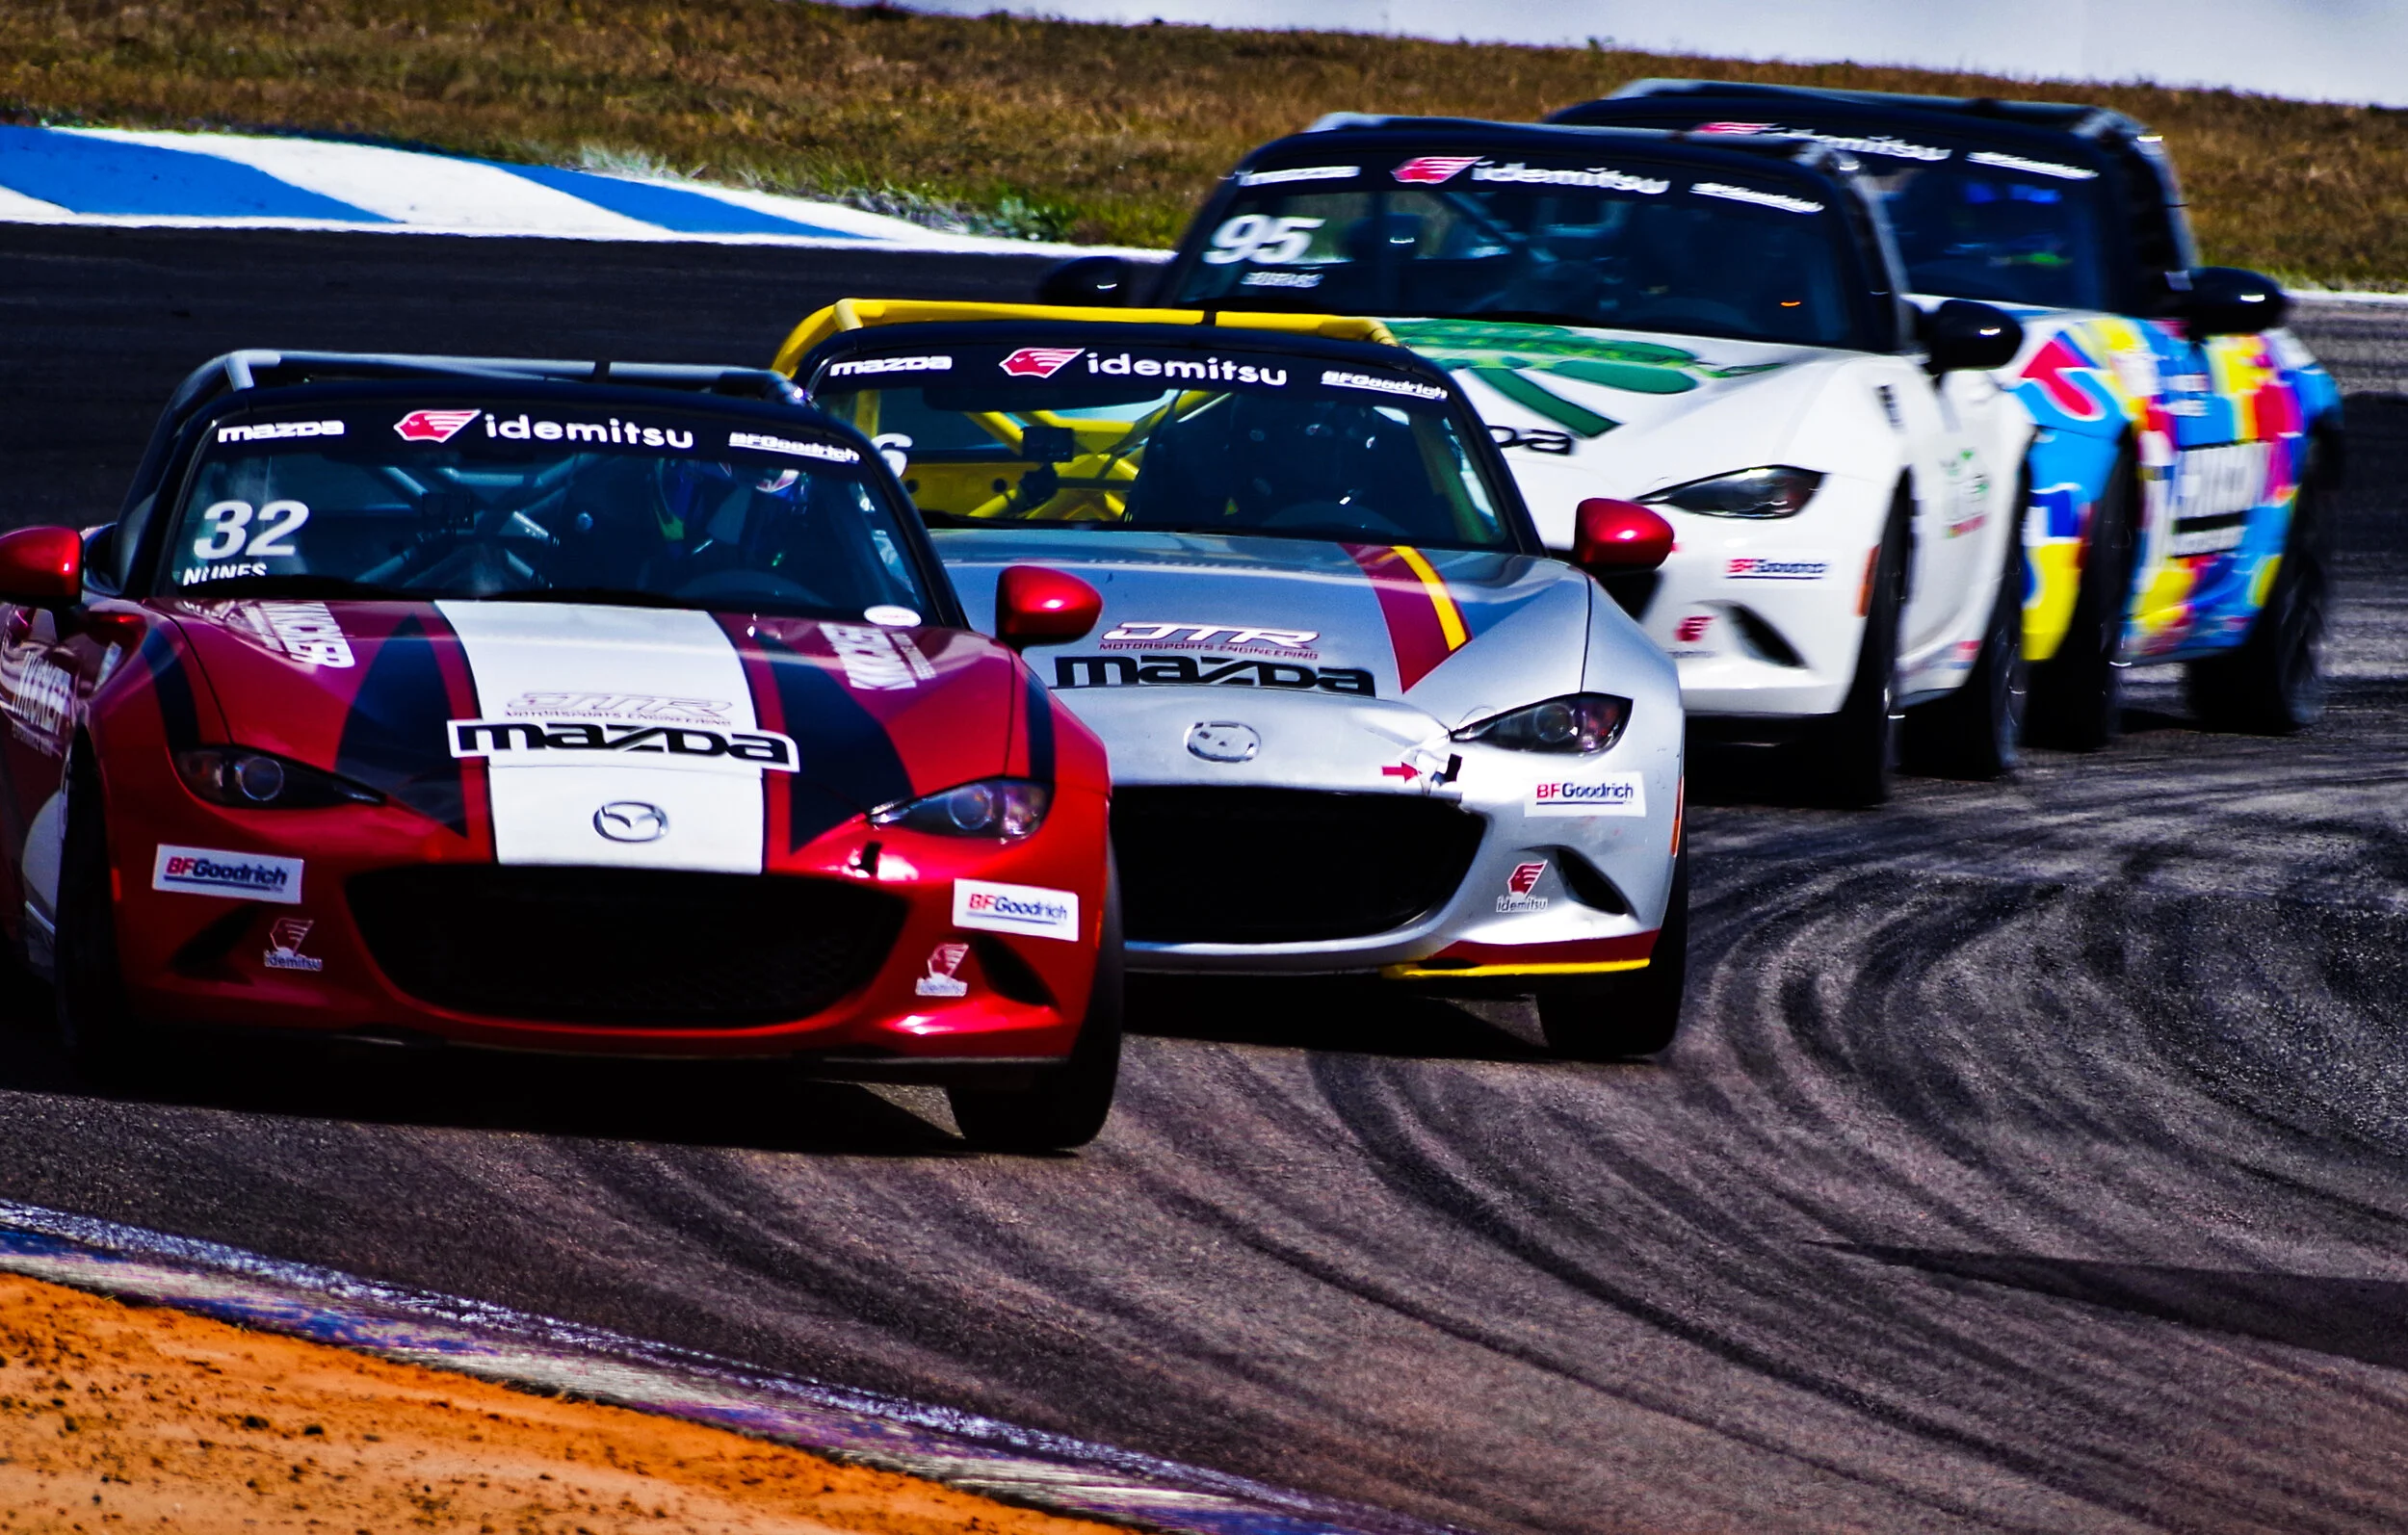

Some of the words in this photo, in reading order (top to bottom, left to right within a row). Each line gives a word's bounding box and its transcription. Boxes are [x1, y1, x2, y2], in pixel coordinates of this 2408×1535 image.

[1203, 214, 1326, 265] 95
[830, 355, 953, 377] mazda
[1086, 351, 1289, 386] idemitsu
[1322, 370, 1449, 400] BFGoodrich
[218, 419, 345, 443] mazda
[484, 413, 694, 449] idemitsu
[729, 431, 860, 462] BFGoodrich
[871, 433, 913, 479] 6
[194, 500, 309, 560] 32
[1102, 621, 1321, 649] JTR
[1099, 641, 1217, 652] MOTORSPORTS
[1218, 644, 1320, 661] ENGINEERING
[1053, 655, 1377, 698] mazda
[456, 722, 791, 766] mazda
[1535, 782, 1635, 801] BFGoodrich
[166, 855, 288, 886] BFGoodrich
[968, 892, 1068, 922] BFGoodrich
[1496, 896, 1548, 913] idemitsu
